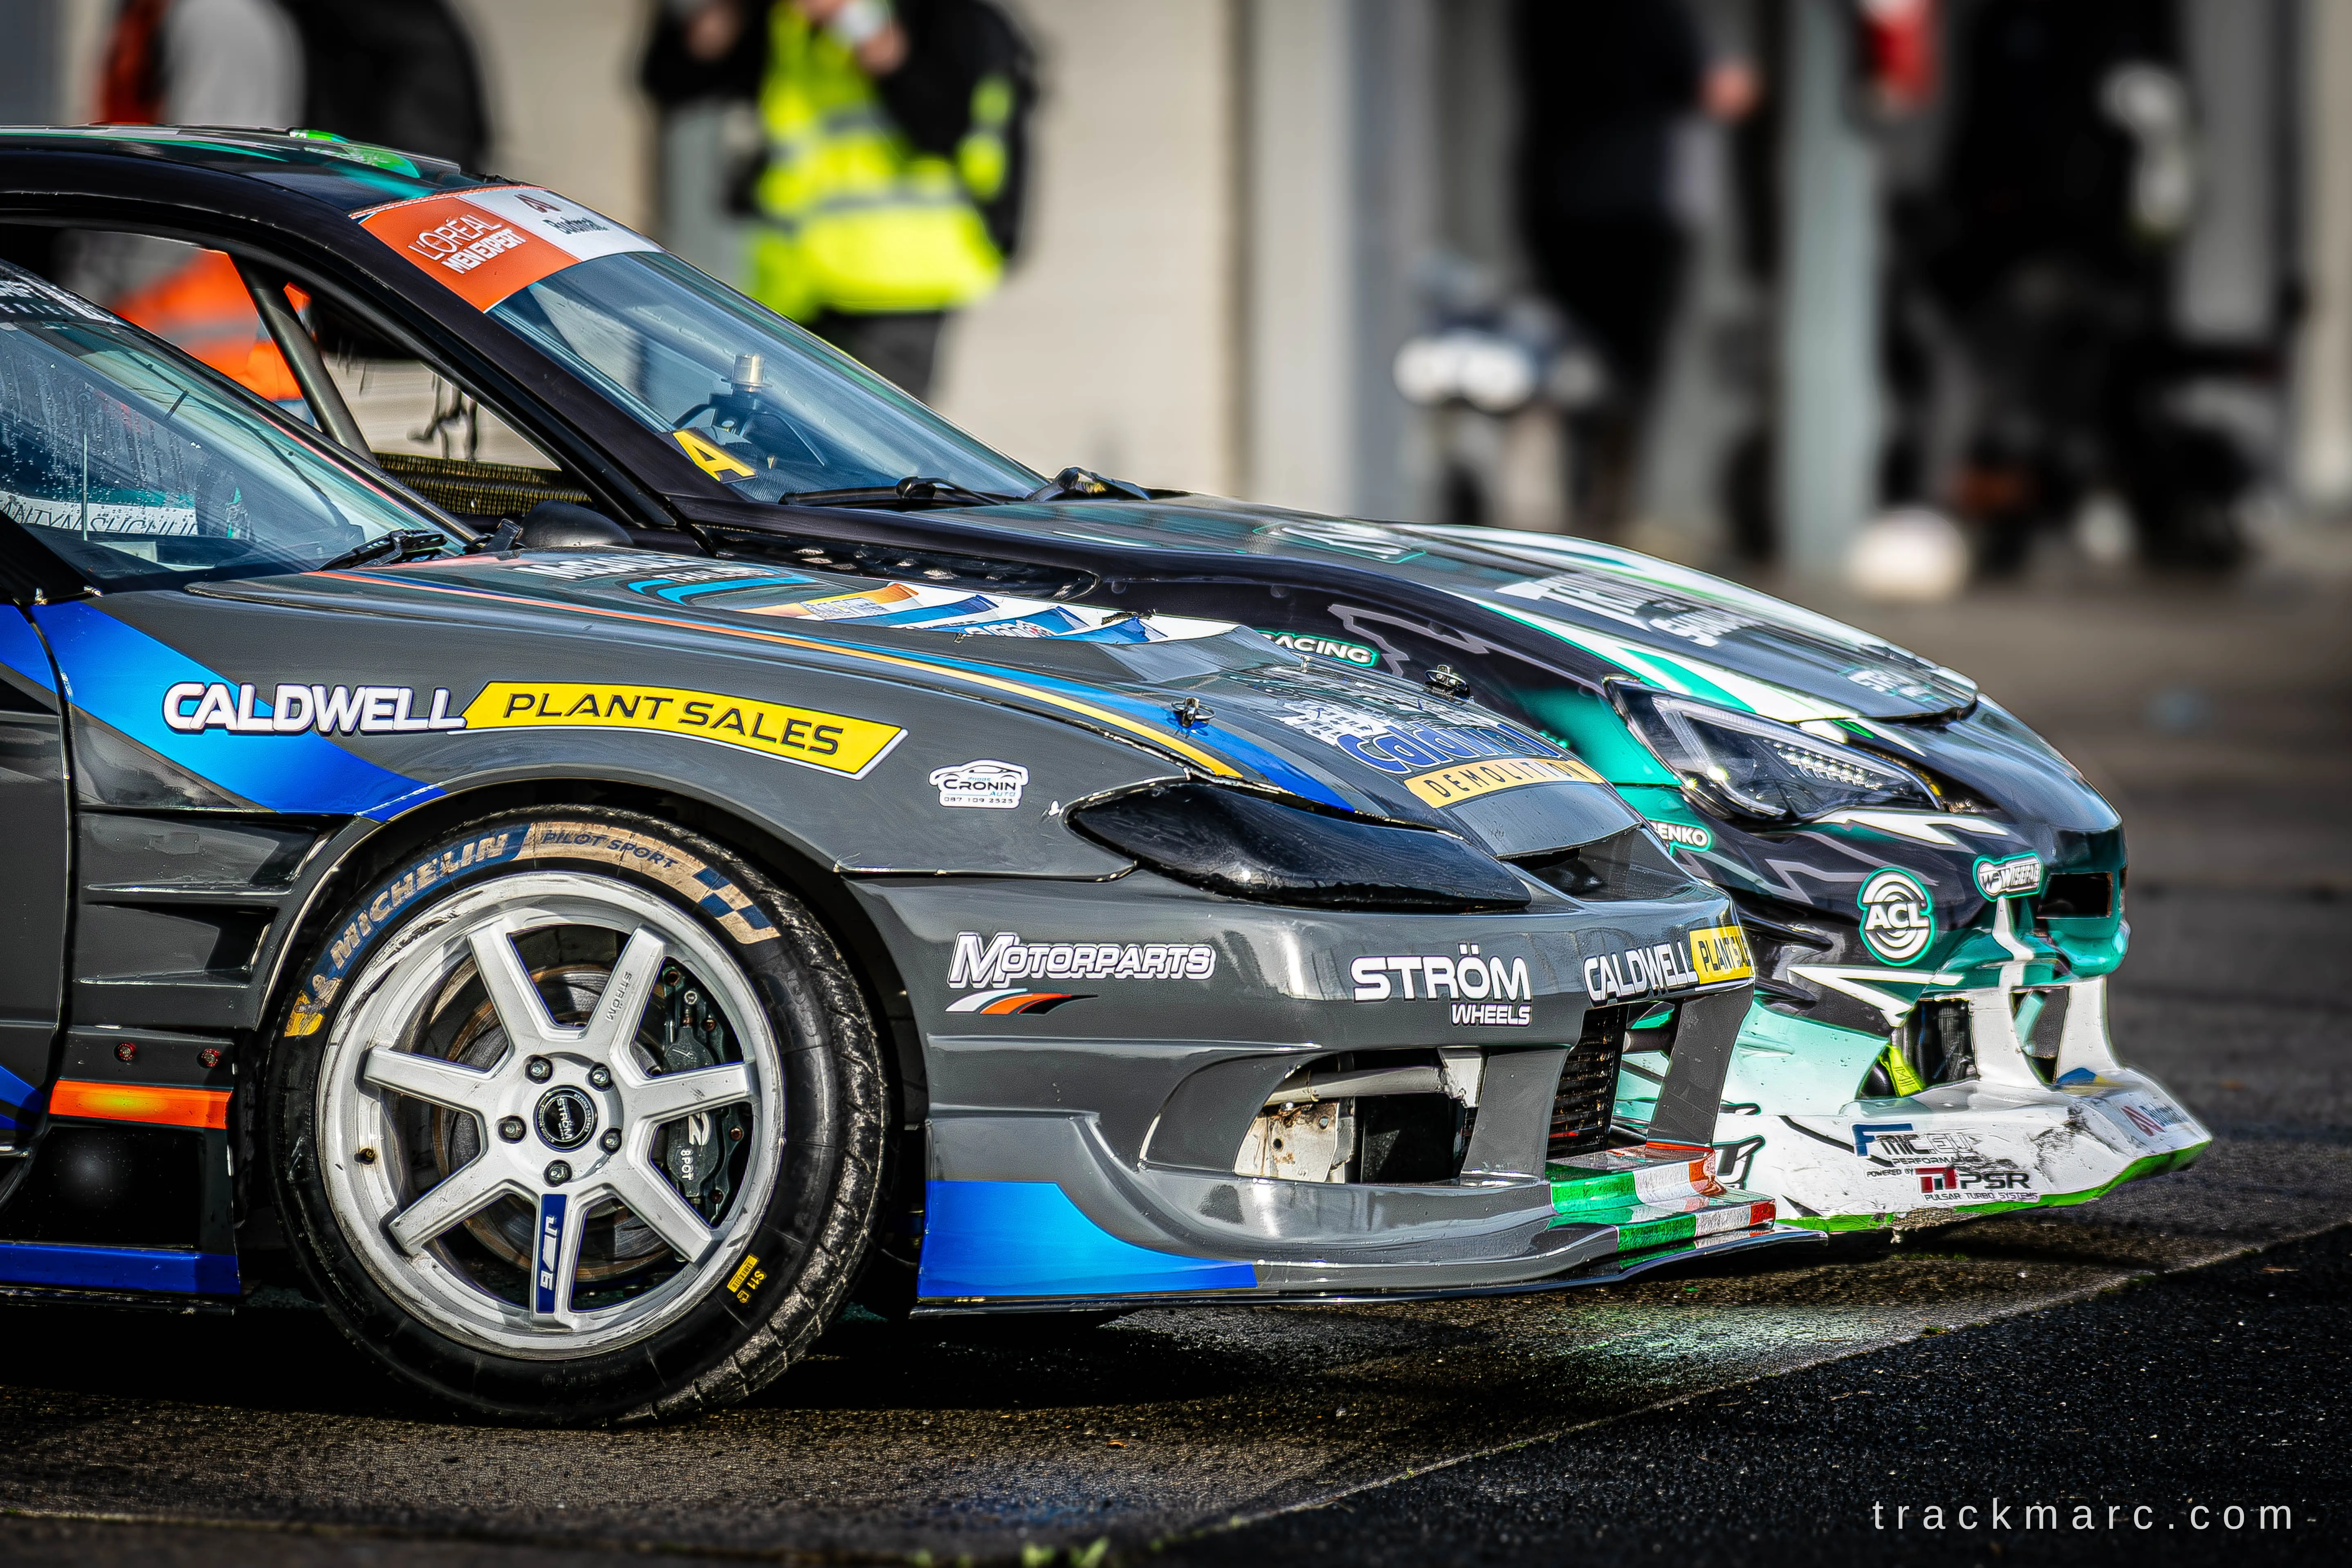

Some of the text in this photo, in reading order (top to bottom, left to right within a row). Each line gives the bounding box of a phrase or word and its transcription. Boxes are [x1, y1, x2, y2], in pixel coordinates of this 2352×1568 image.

[407, 214, 503, 260] L'ORÉAL
[440, 228, 527, 274] MEN EXPERT
[672, 429, 756, 482] A
[163, 682, 844, 755] CALDWELL PLANT SALES
[943, 778, 1016, 791] CRONIN
[1423, 761, 1591, 798] DEMOLITION
[541, 830, 679, 868] PILOT SPORT
[330, 833, 509, 969] MICHELIN
[1865, 902, 1929, 930] ACL
[947, 931, 1217, 989] MOTORPARTS
[1350, 943, 1531, 1003] STRÖM
[1584, 940, 1699, 1001] CALDWELL
[1698, 937, 1735, 972] PLANT
[605, 971, 632, 1021] STRÖM
[1451, 1004, 1531, 1025] WHEELS
[557, 1097, 574, 1140] STRÖM
[1867, 1169, 1902, 1177] POWERED
[1959, 1172, 2031, 1190] PSR
[1924, 1193, 1961, 1201] PULSAR
